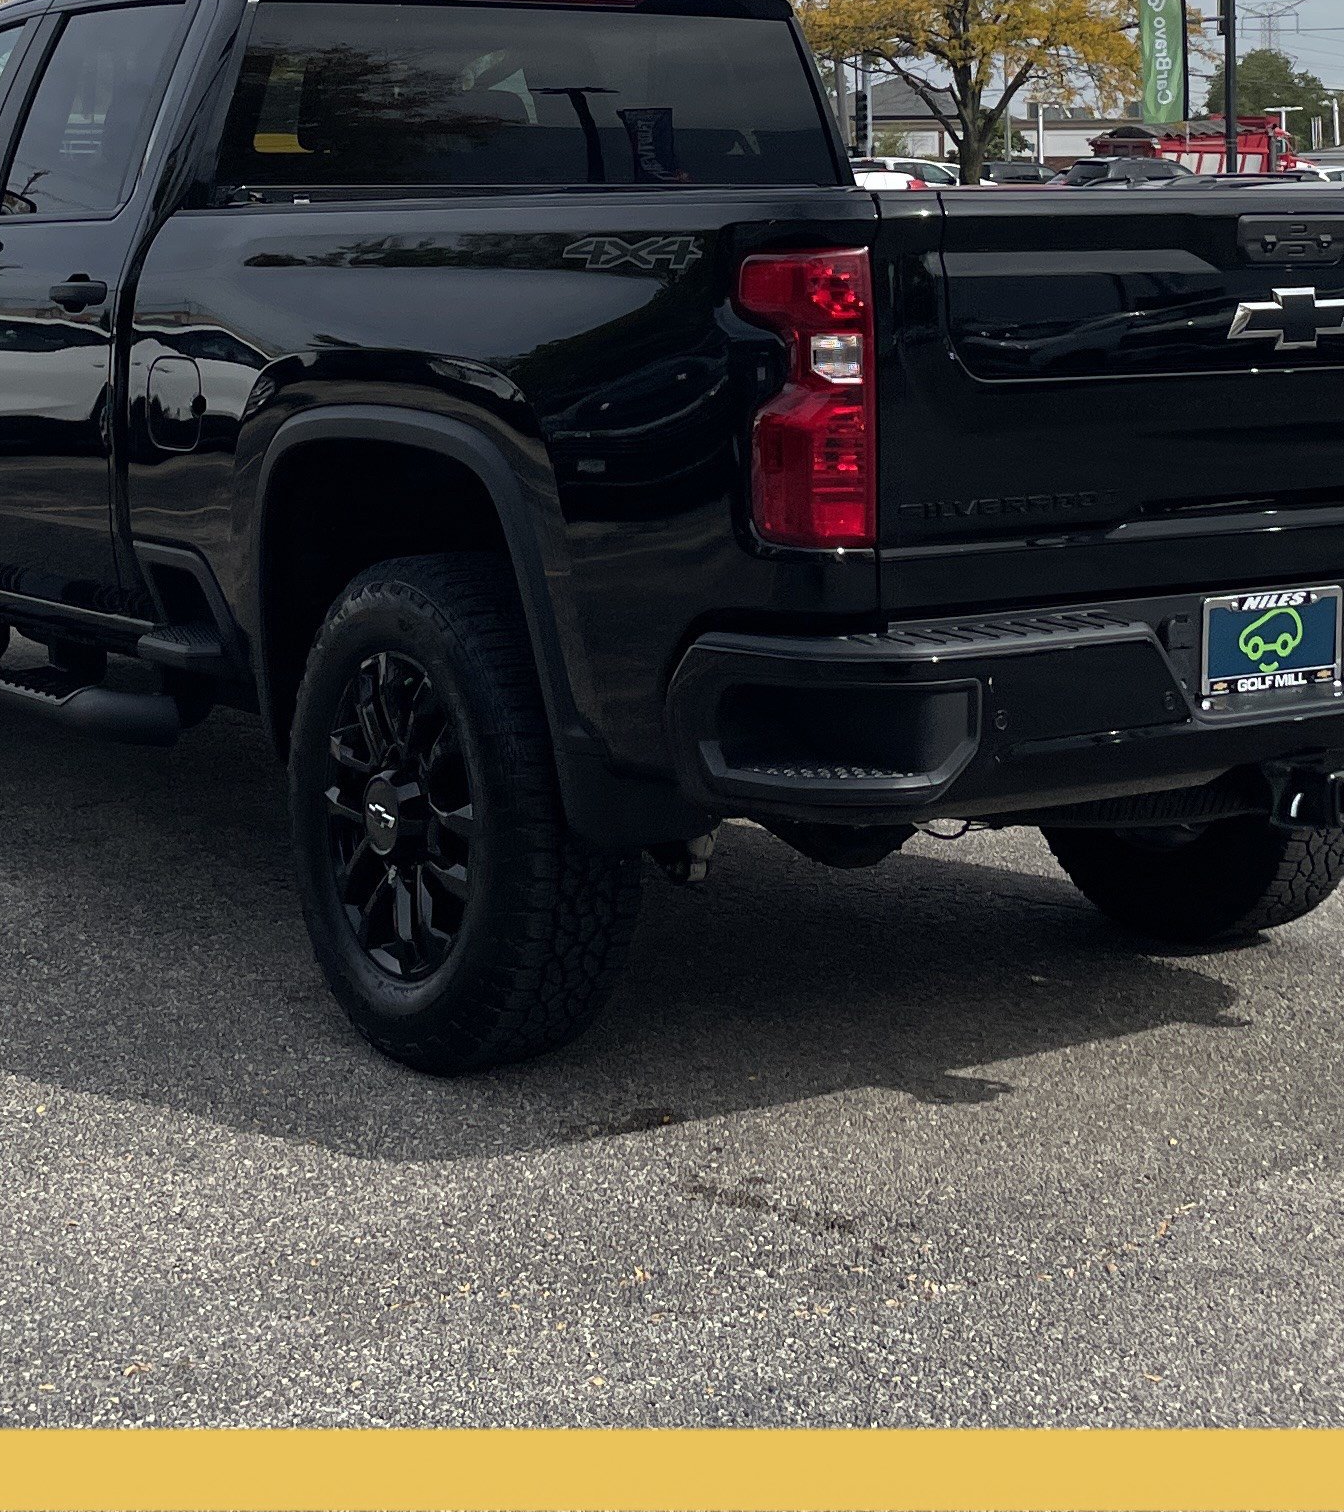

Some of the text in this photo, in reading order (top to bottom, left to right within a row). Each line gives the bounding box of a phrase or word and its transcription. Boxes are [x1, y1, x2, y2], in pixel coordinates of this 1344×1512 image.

[1242, 592, 1307, 611] NILES
[1237, 672, 1307, 692] GOLF MILL
